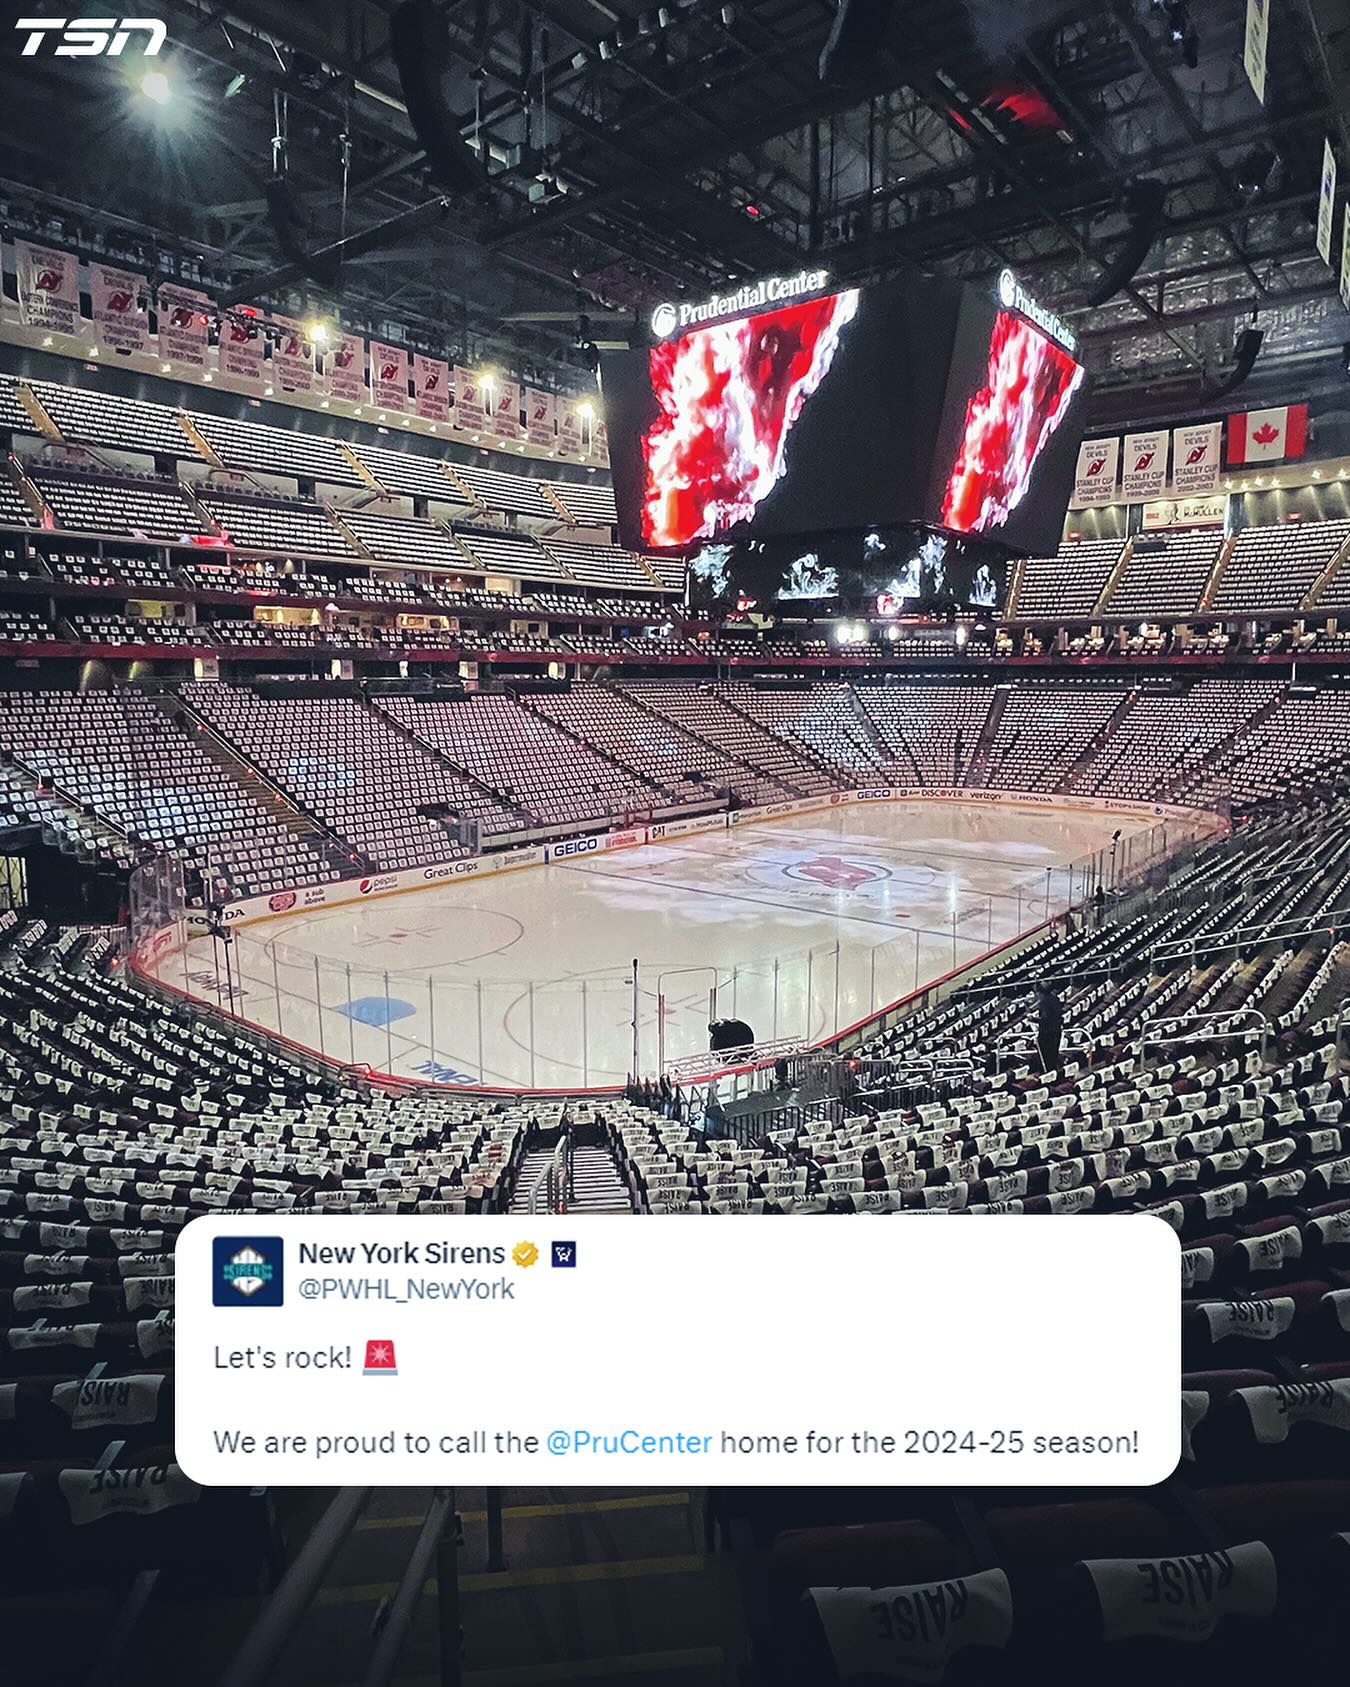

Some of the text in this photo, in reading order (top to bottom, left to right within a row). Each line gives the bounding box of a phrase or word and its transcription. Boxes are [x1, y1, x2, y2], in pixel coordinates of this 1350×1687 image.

[679, 270, 828, 327] Prudential Center
[1184, 436, 1209, 446] DEVILS
[1134, 444, 1157, 452] DEVILS
[1086, 450, 1109, 459] DEVILS
[1175, 464, 1218, 476] STANLEY CUP
[1123, 470, 1165, 482] STANLEY CUP
[1175, 473, 1216, 485] CHAMPIONS
[1076, 478, 1101, 488] STANLEY
[1124, 479, 1162, 490] CHAMPIONS
[1077, 486, 1113, 496] CHAMPIONS
[857, 789, 891, 800] GEICO
[921, 788, 963, 798] DISCOVER
[554, 838, 598, 857] GEICO
[424, 862, 479, 880] Great Clips
[187, 908, 245, 926] HODA
